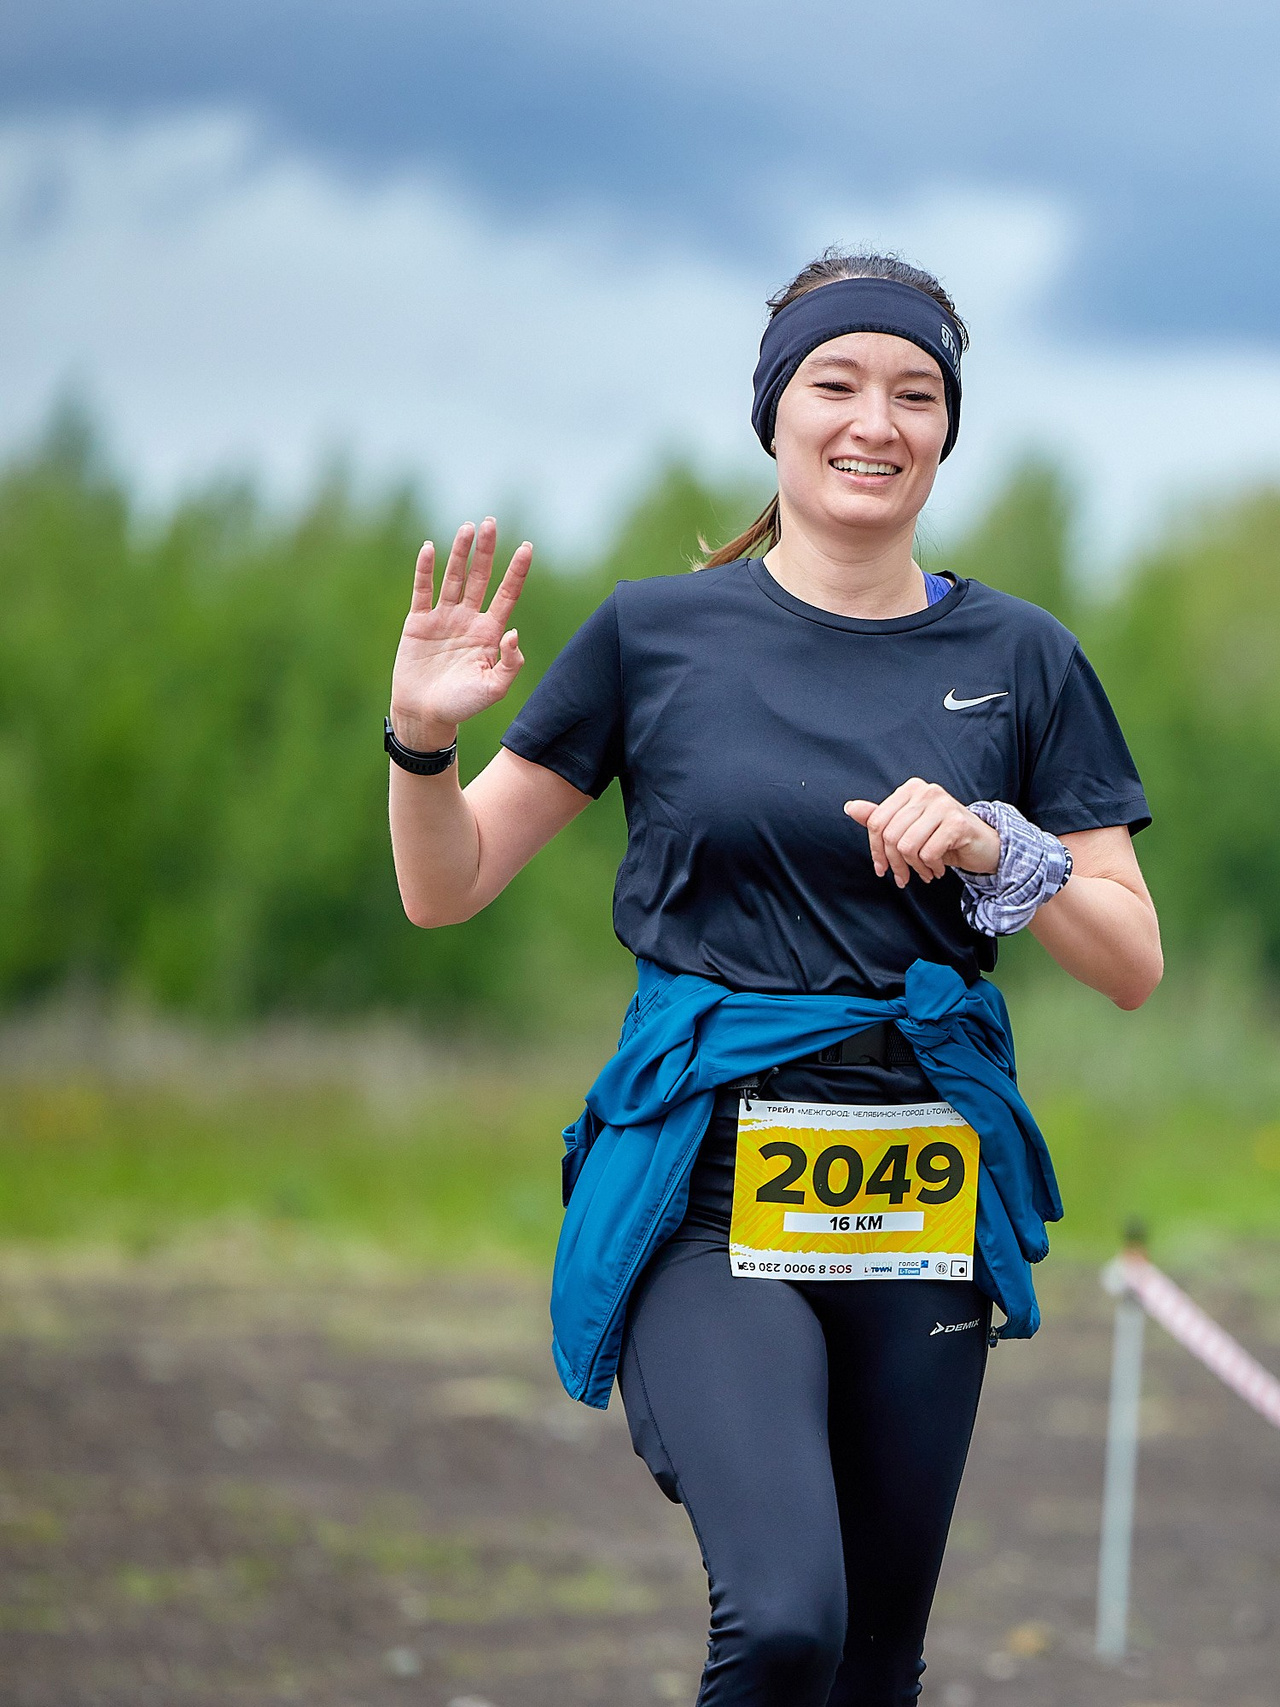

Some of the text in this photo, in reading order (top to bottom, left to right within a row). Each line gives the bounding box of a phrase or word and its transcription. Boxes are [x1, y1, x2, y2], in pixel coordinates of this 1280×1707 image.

[767, 1105, 795, 1114] ТРЕЙЛ
[756, 1141, 965, 1207] 2049
[829, 1215, 851, 1231] 16
[758, 1262, 781, 1273] 230
[784, 1263, 816, 1274] 9000
[818, 1264, 827, 1274] 8
[828, 1264, 852, 1274] SOS
[944, 1318, 981, 1333] DEMIX
